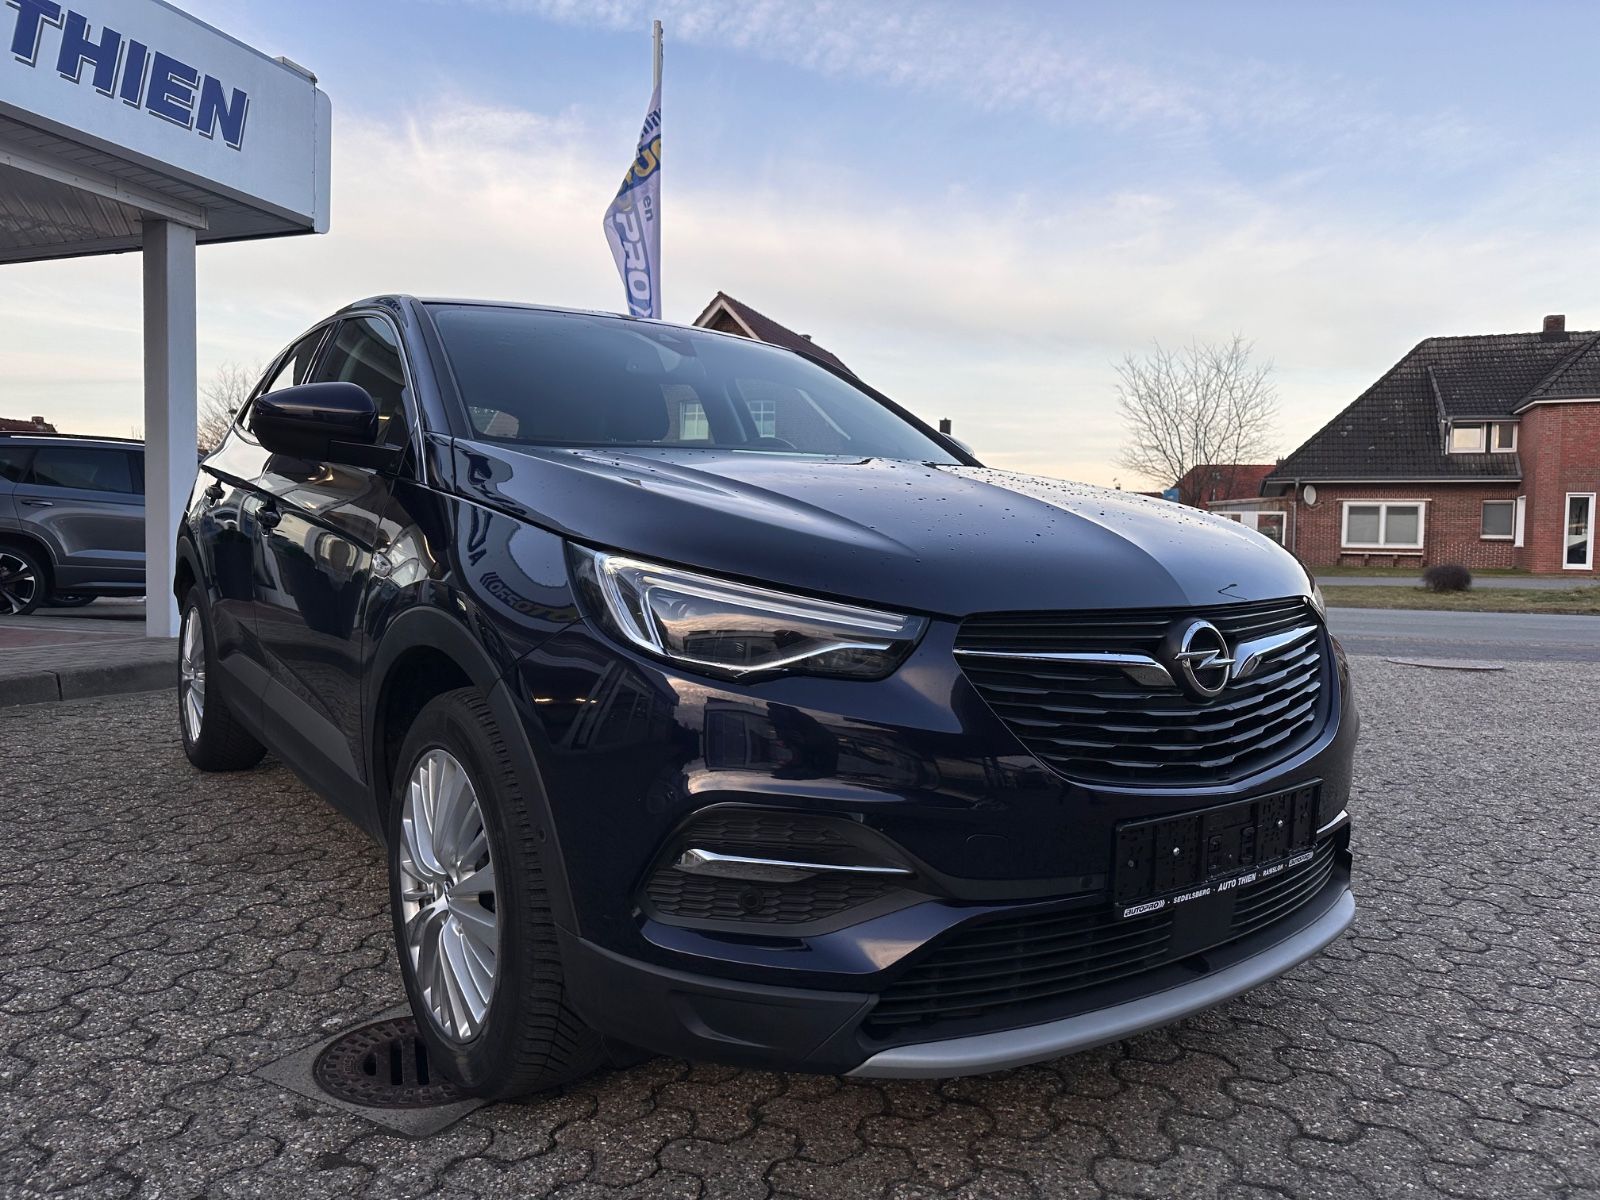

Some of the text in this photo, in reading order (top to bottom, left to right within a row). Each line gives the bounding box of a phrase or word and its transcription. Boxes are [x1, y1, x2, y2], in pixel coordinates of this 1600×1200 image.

[4, 0, 249, 151] THIEN
[1173, 888, 1211, 904] SEDELSBERG
[1218, 879, 1237, 892] AUTO
[1238, 872, 1257, 886] THIEN
